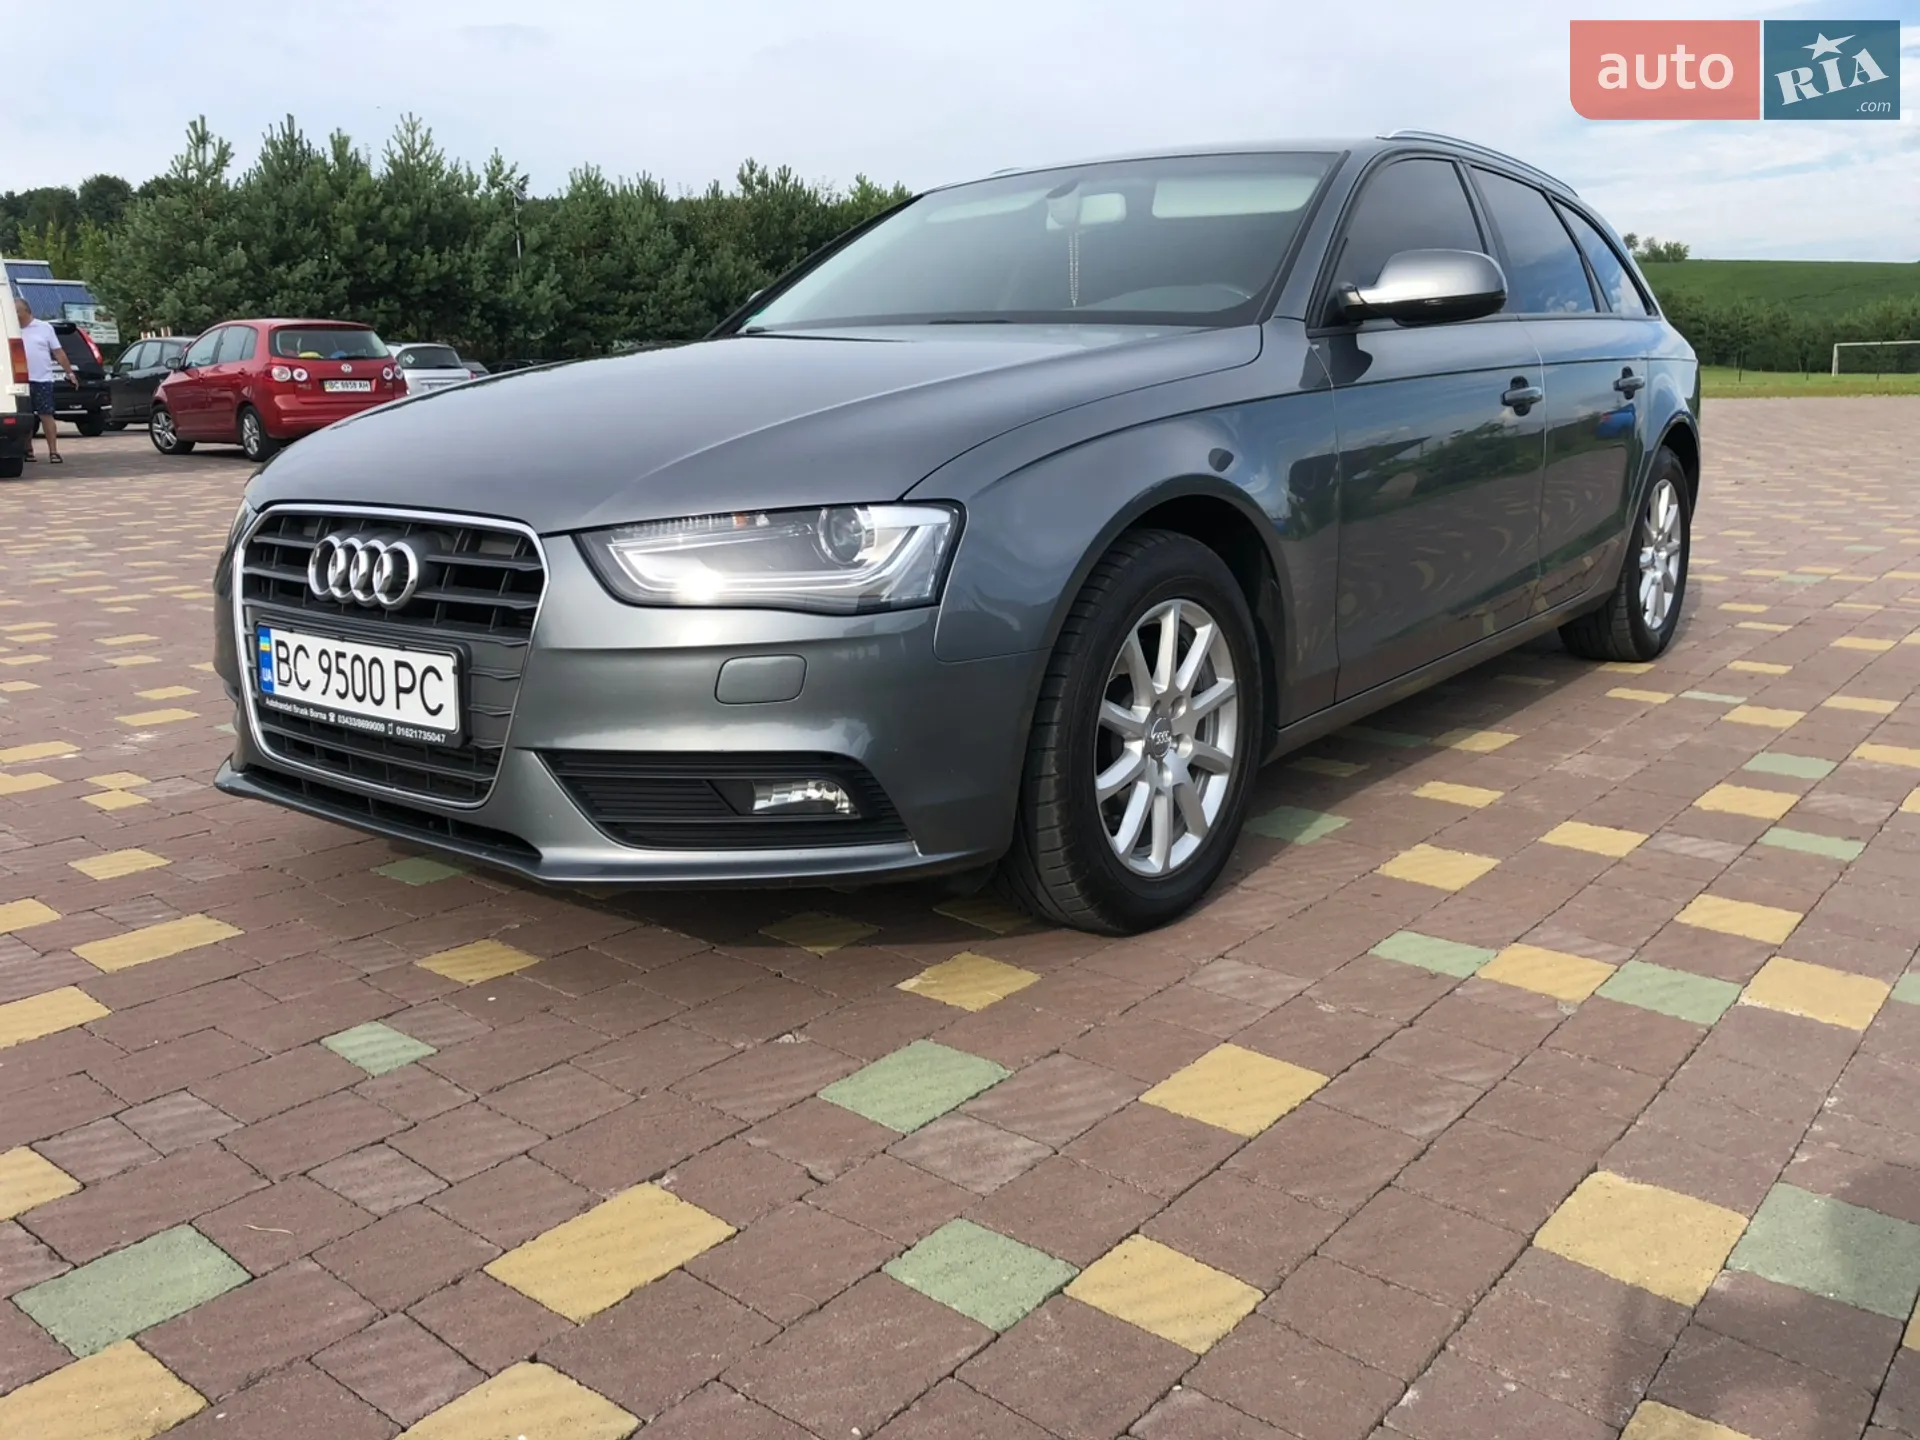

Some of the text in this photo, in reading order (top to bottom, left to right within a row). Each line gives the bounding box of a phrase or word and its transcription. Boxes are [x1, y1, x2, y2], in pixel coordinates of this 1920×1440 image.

[262, 668, 273, 682] UA
[275, 639, 444, 716] BC 9500 PC
